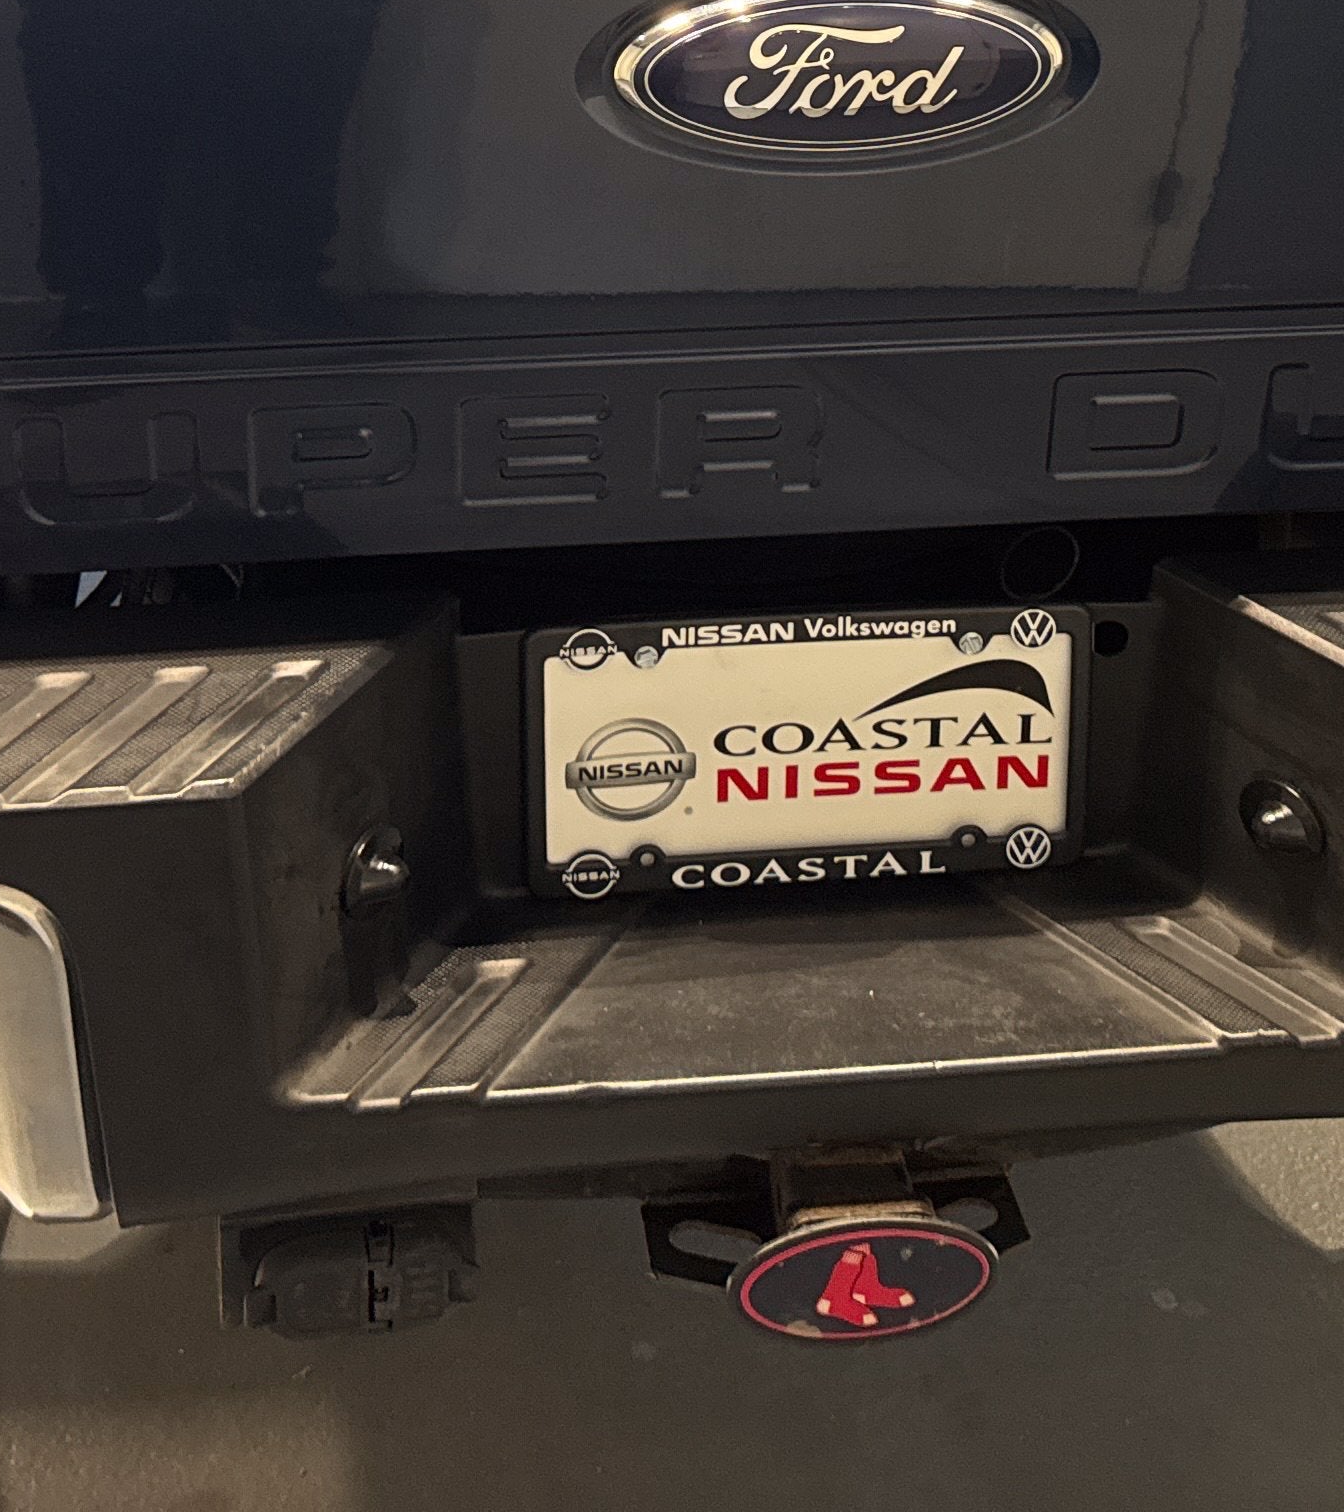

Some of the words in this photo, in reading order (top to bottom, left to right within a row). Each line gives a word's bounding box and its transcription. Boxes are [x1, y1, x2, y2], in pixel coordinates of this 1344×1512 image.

[723, 23, 965, 120] Ford
[661, 621, 795, 648] NISSAN
[803, 615, 957, 639] Volkswagen
[559, 645, 618, 658] NISSAN
[712, 711, 1053, 757] COASTAL
[578, 759, 683, 782] NISSAN
[716, 754, 1050, 803] NISSAN
[561, 869, 621, 883] NISSAN
[671, 850, 947, 889] COASTAL
